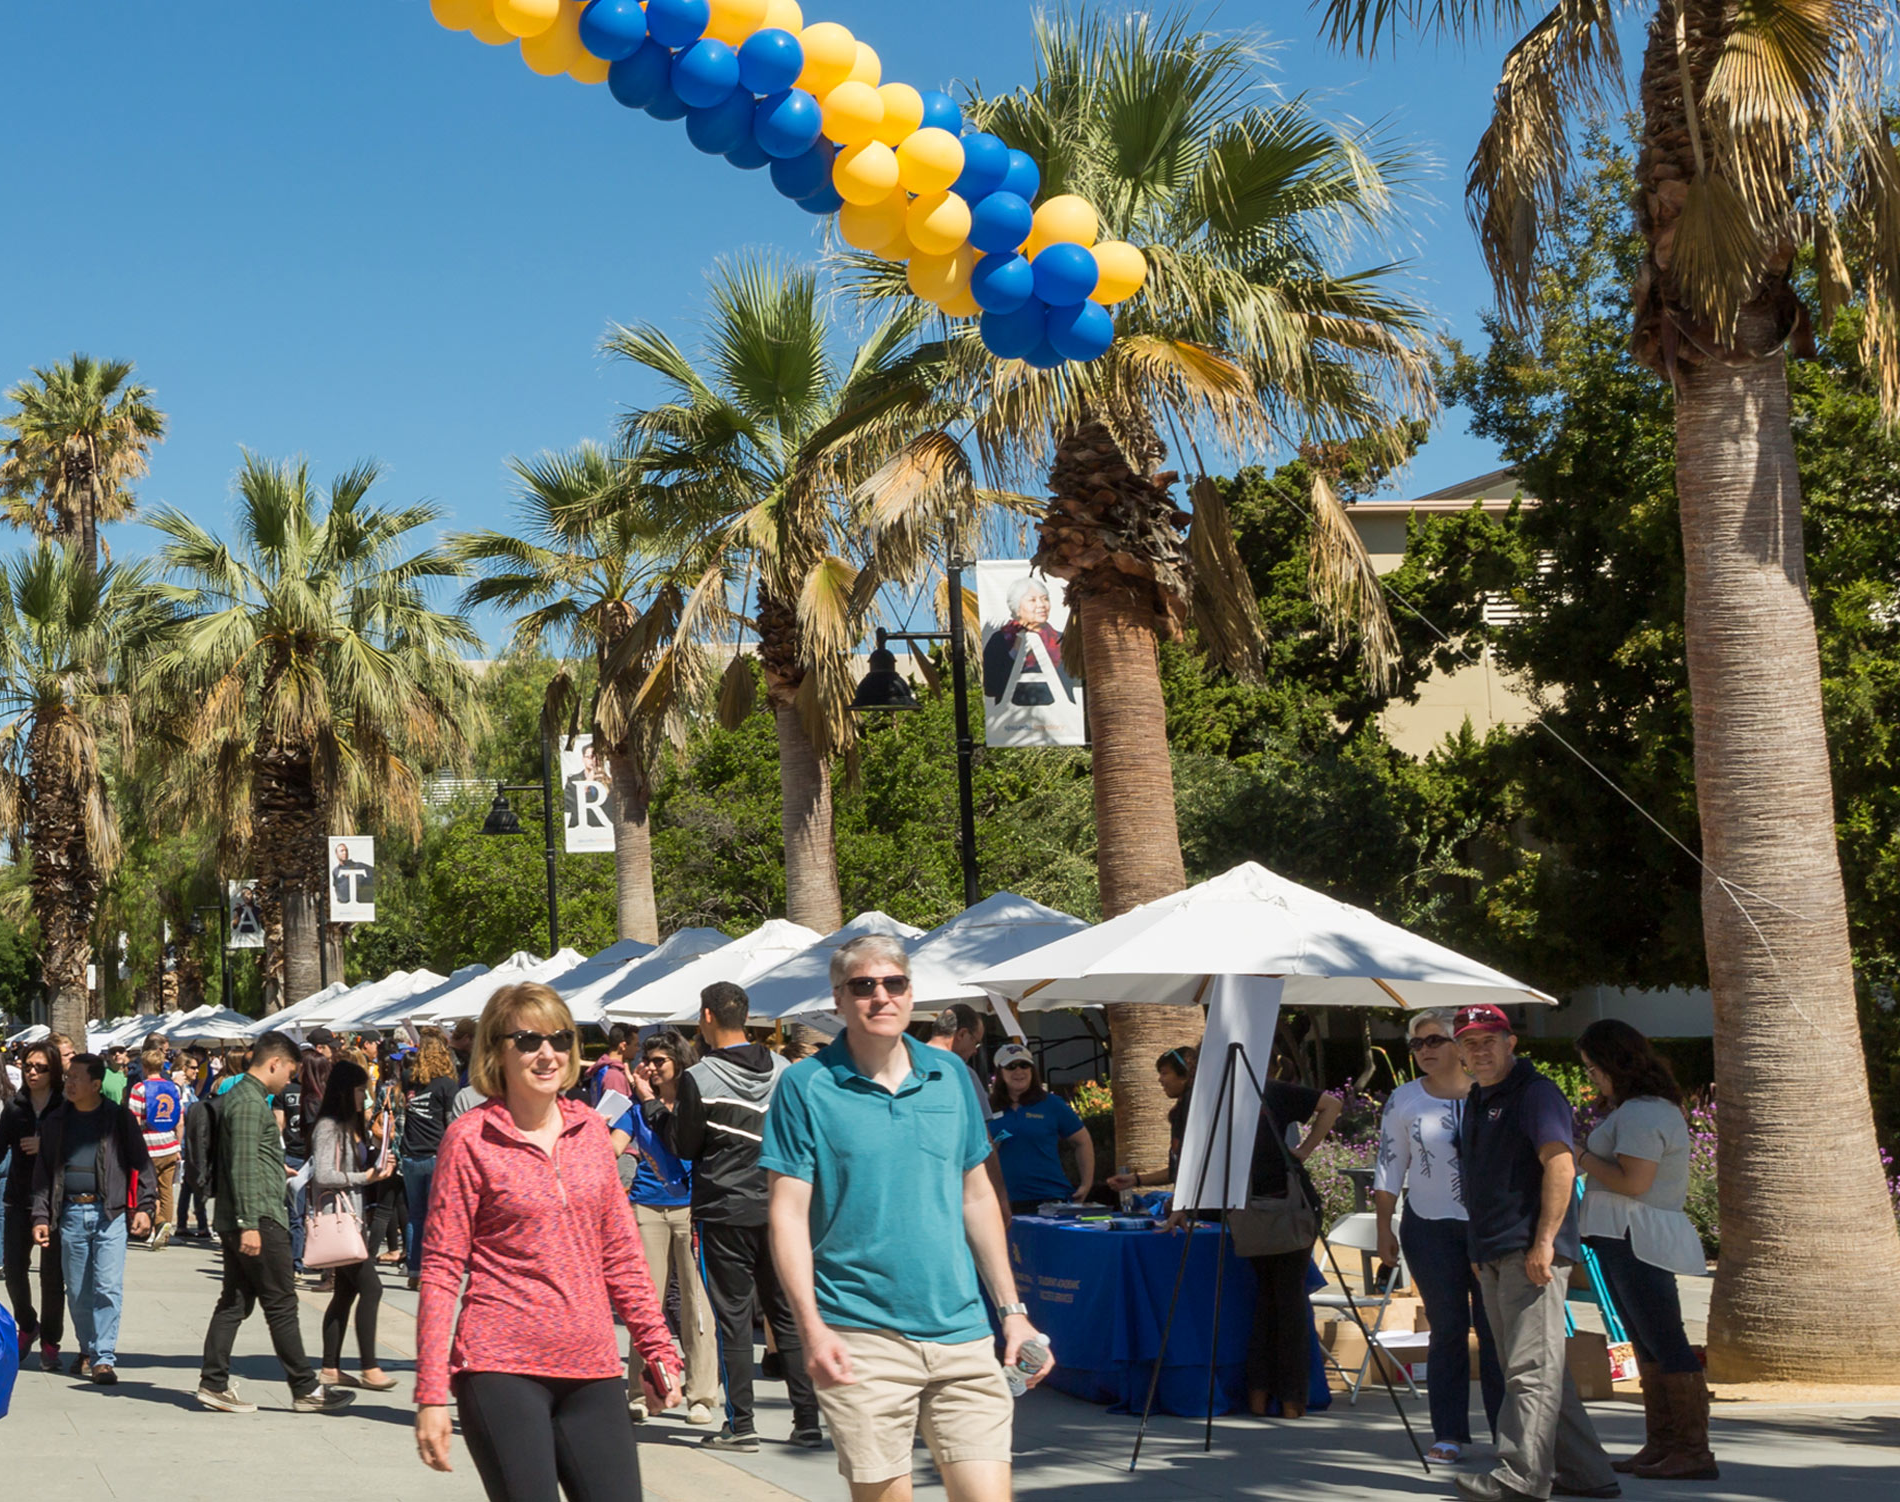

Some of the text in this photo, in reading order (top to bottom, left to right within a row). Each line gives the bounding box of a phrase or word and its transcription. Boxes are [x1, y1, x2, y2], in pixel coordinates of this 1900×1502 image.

[994, 632, 1077, 707] A
[568, 780, 614, 829] R
[337, 869, 368, 905] T
[236, 906, 263, 933] A
